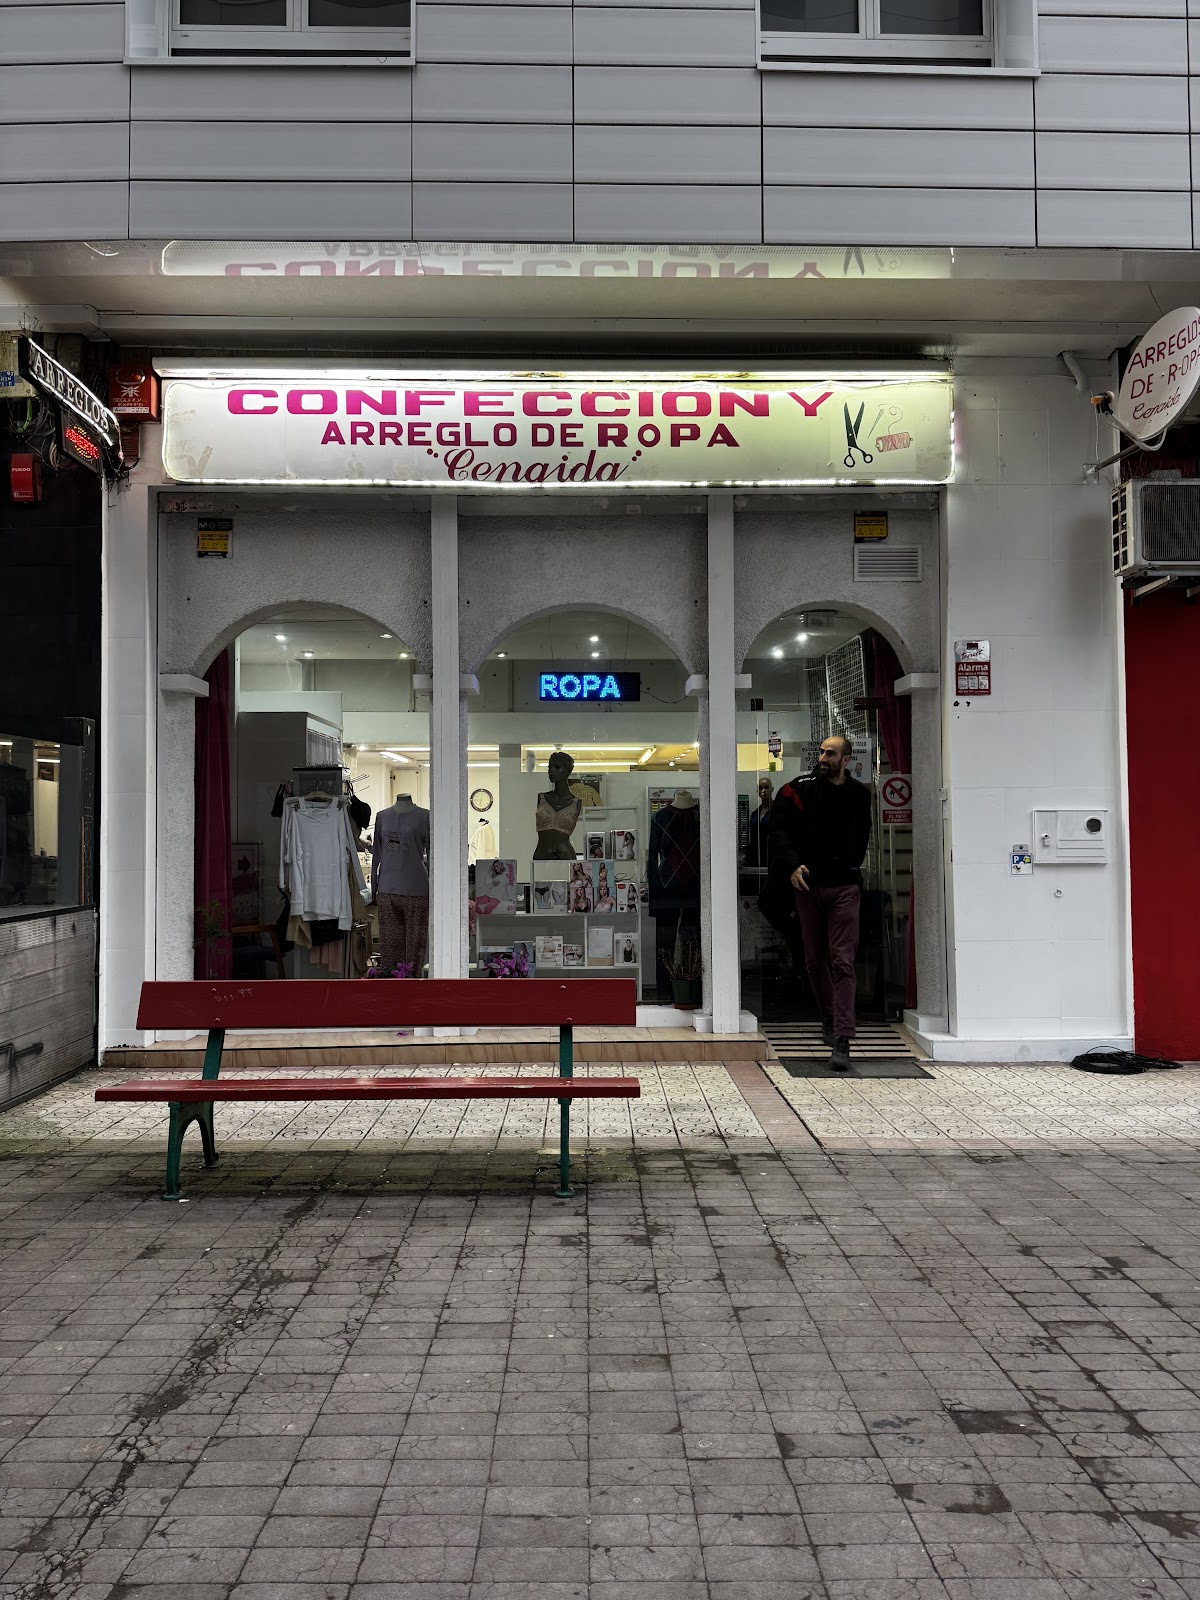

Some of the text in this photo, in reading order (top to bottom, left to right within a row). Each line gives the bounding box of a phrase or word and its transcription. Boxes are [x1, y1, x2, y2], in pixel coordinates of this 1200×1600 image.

[34, 350, 110, 432] ARREGLOS
[1131, 373, 1154, 399] DE
[228, 389, 834, 417] CONFECCION Y
[321, 421, 740, 448] ARREGLO DE ROPA
[958, 663, 988, 671] Alarma
[541, 674, 621, 698] ROPA
[1013, 855, 1020, 864] P
